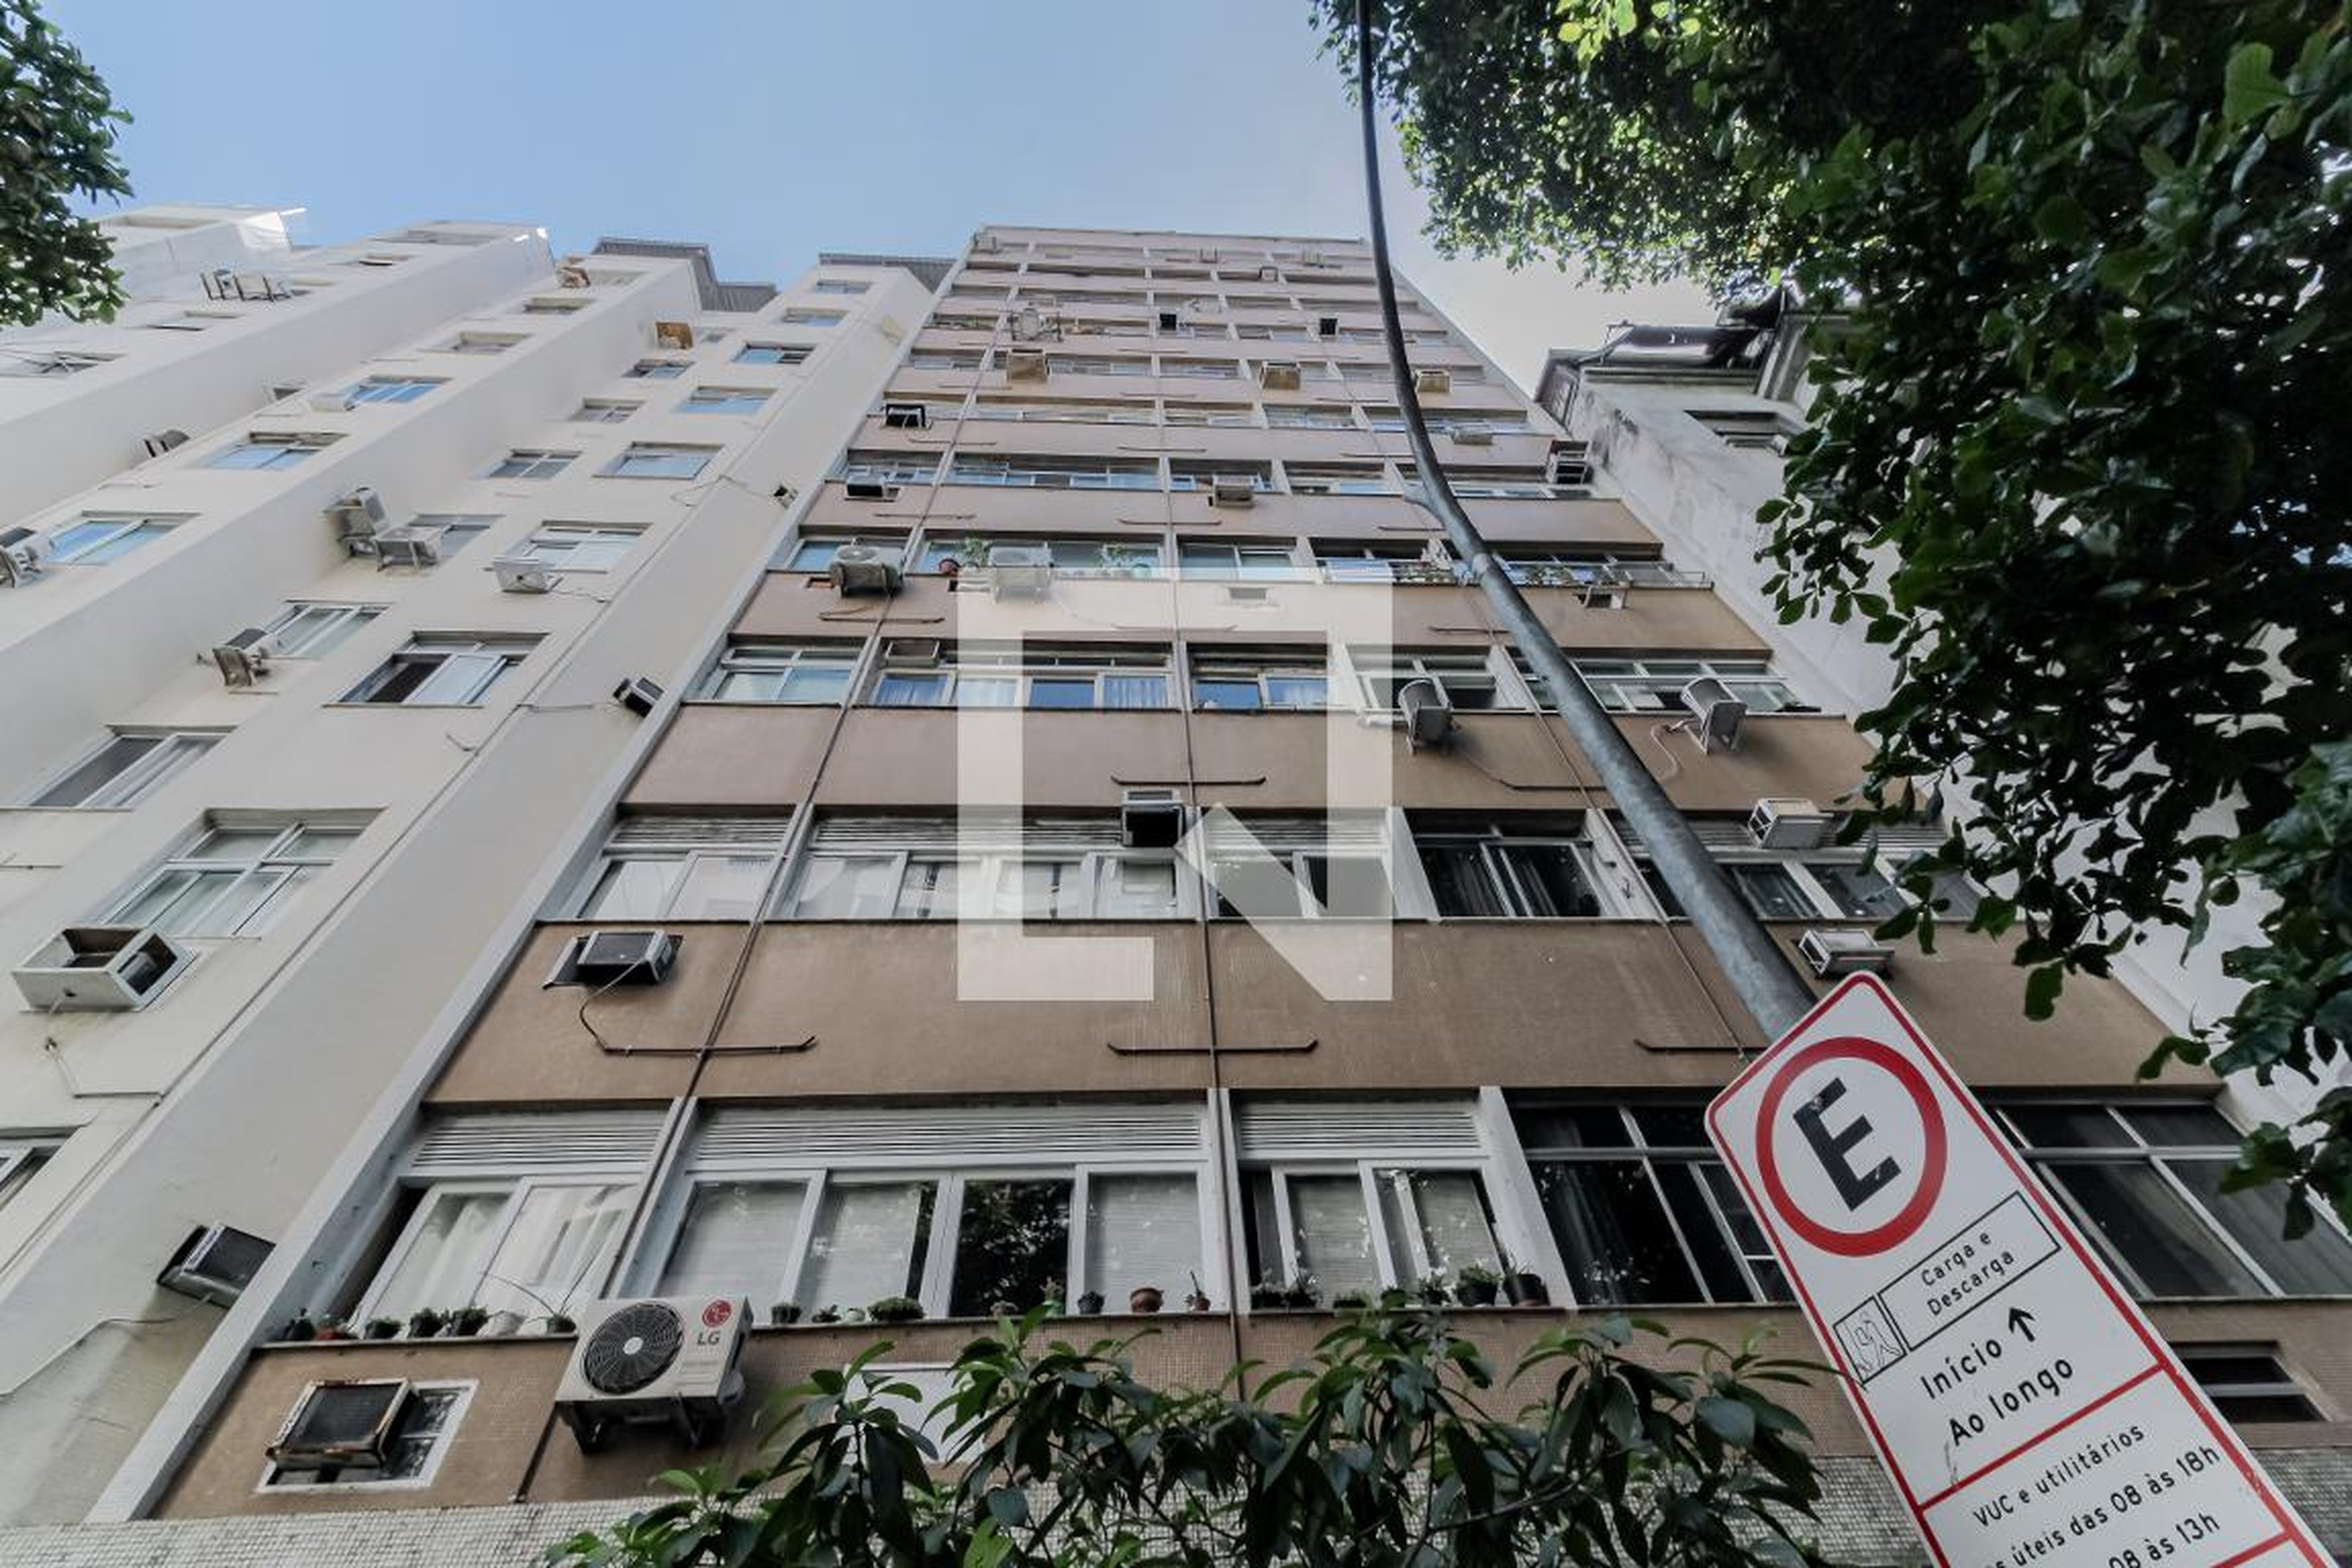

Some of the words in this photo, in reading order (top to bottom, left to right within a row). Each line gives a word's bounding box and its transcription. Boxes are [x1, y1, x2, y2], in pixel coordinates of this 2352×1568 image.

[1792, 1077, 1902, 1212] E
[1921, 1245, 1975, 1286] Carga
[1980, 1232, 1991, 1245] e
[1926, 1251, 2015, 1316] Descarga
[697, 1331, 720, 1346] LG
[1920, 1339, 2002, 1400] Início
[1949, 1414, 1985, 1447] Ao
[1988, 1359, 2073, 1420] longo
[1972, 1494, 2014, 1527] VUC
[2018, 1489, 2030, 1504] e
[2035, 1426, 2144, 1494] utilitários
[2011, 1530, 2065, 1567] úteis
[2070, 1507, 2108, 1536] das
[2110, 1485, 2142, 1513] 08
[2144, 1471, 2175, 1495] às
[2176, 1446, 2220, 1477] 18h
[2108, 1549, 2141, 1568] 08
[2144, 1537, 2175, 1561] às
[2176, 1513, 2220, 1544] 13h
